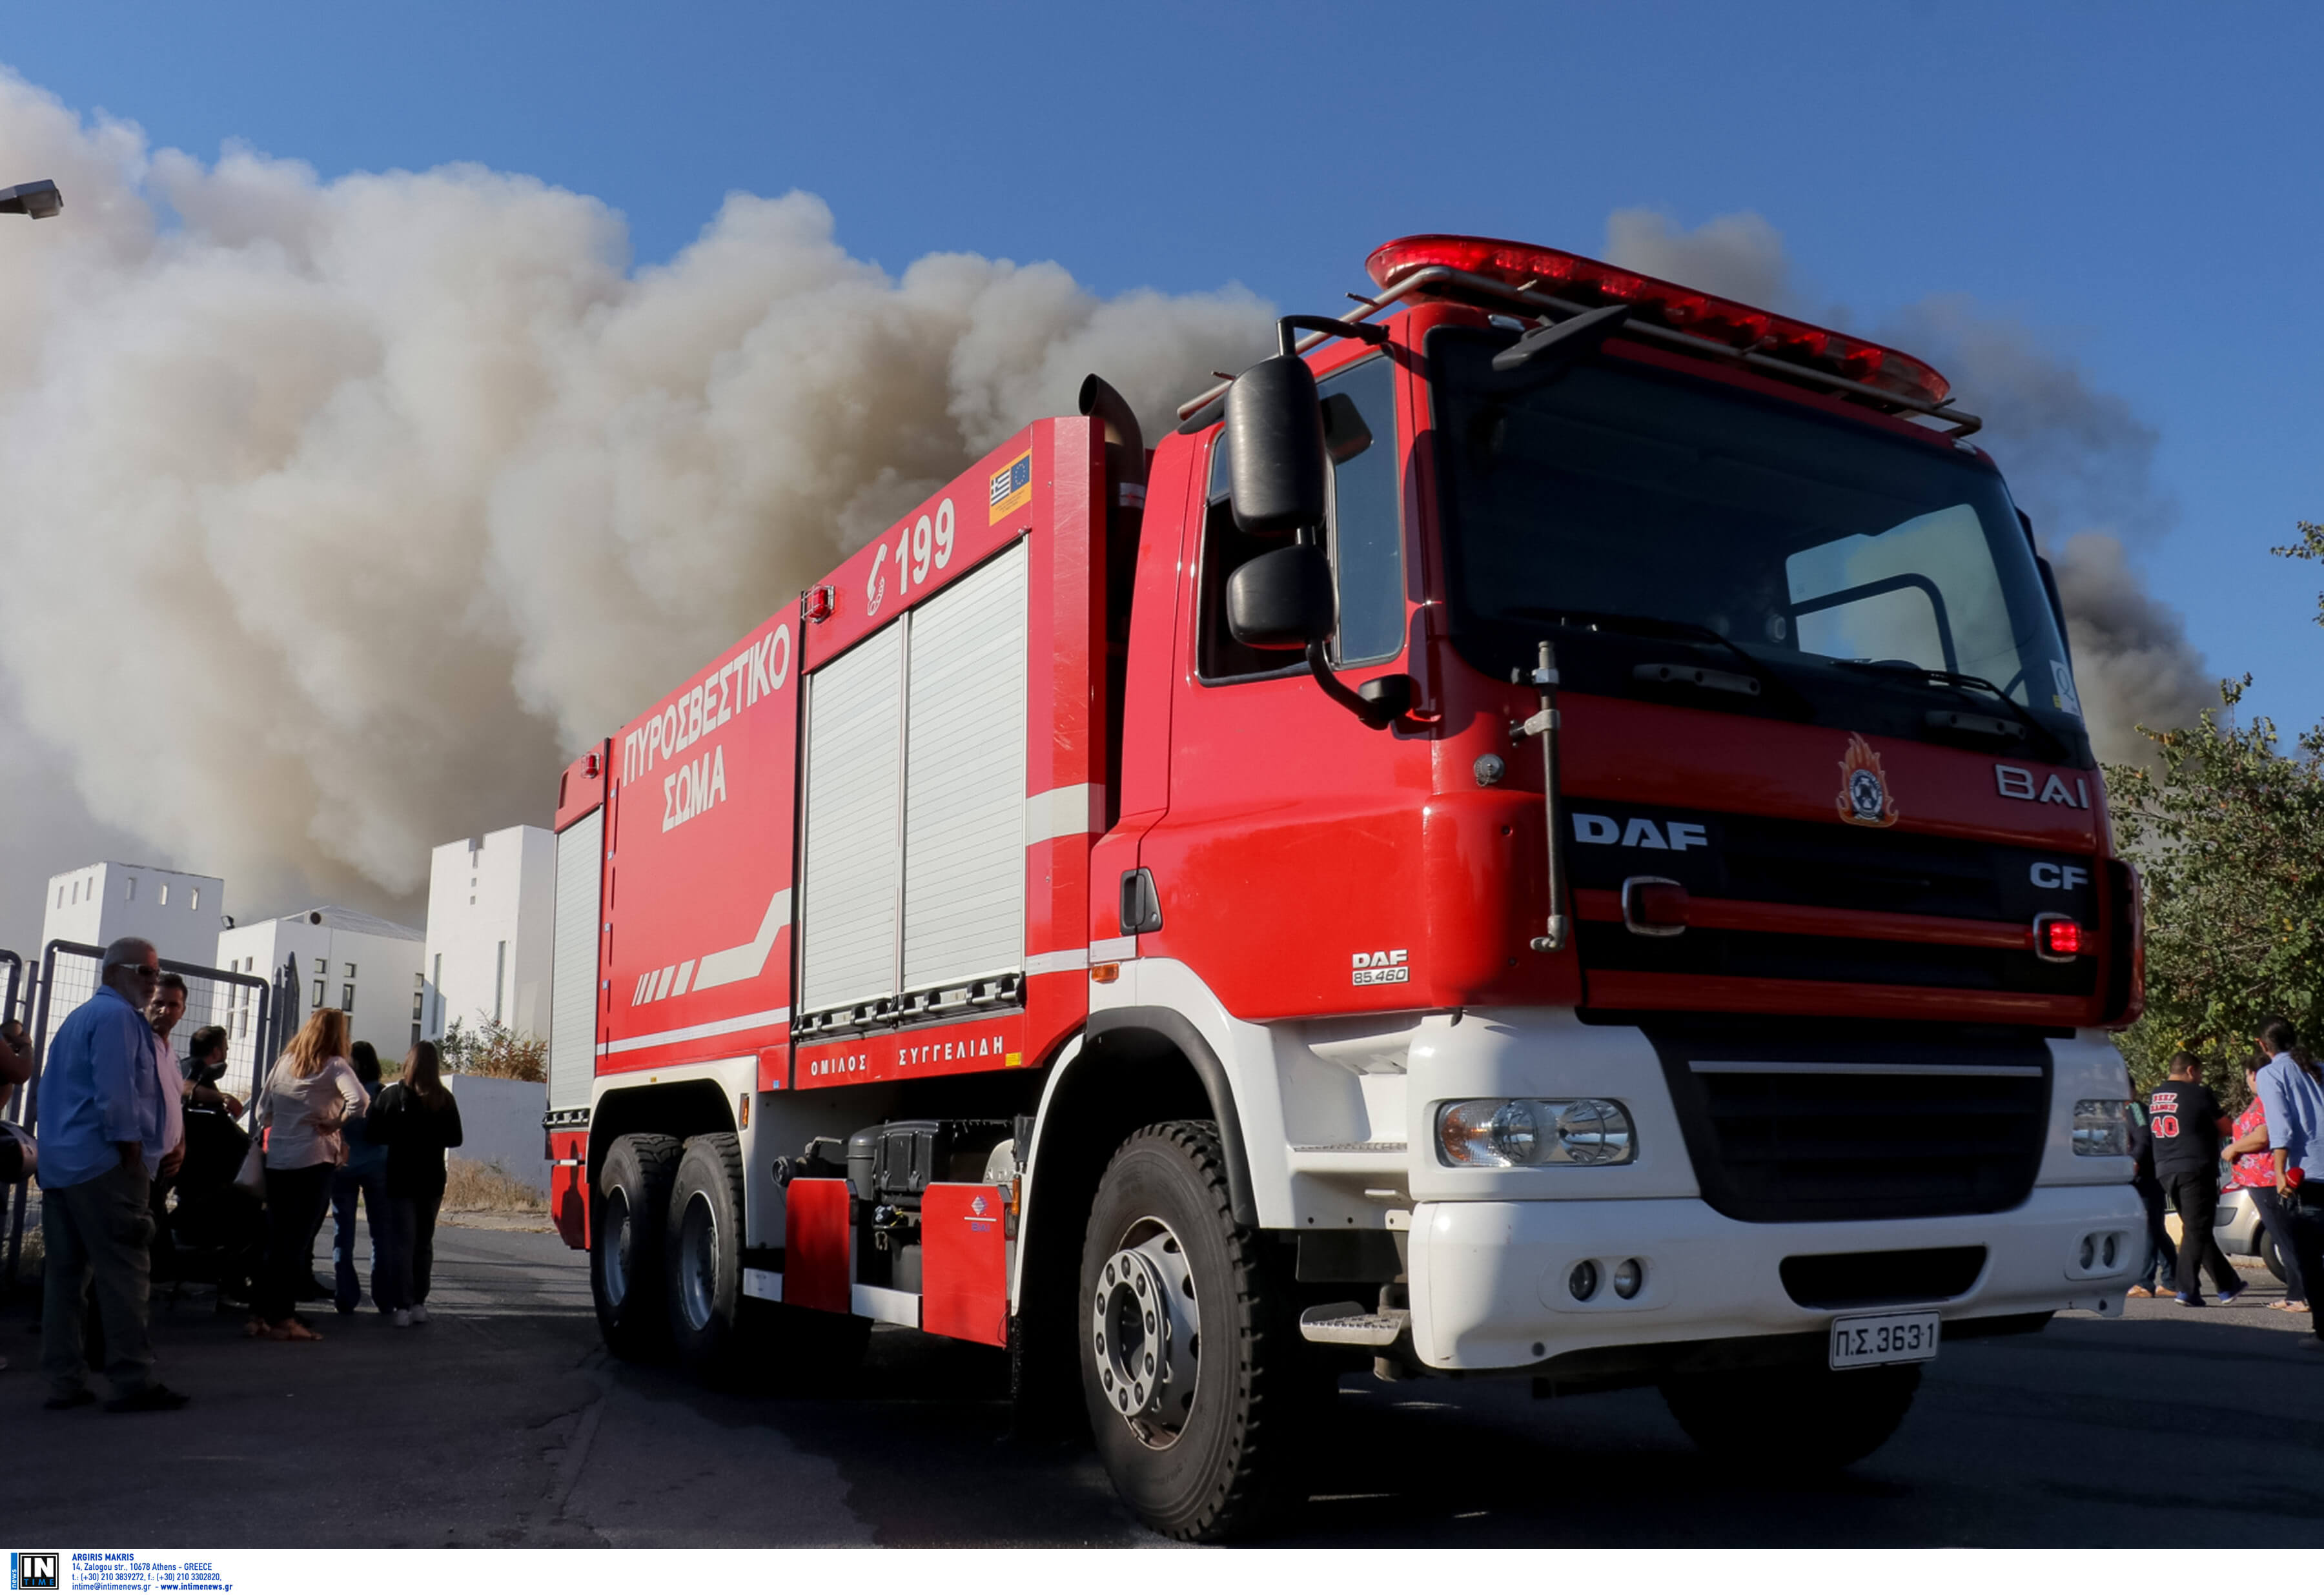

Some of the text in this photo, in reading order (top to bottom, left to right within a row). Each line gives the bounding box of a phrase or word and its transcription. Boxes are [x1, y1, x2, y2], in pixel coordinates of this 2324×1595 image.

[895, 498, 955, 594] 199
[623, 624, 790, 787] ΠΥΡΟΣΒΕΣΤΙΚΟ
[662, 744, 726, 833] ΣΩΜΑ
[1571, 813, 1708, 851] DAF
[2030, 862, 2089, 891] CF
[1352, 949, 1409, 969] DAF
[1354, 968, 1407, 984] 85.460
[811, 1054, 866, 1076] ΟΜΙΛΟΣ
[899, 1036, 1003, 1066] ΣΥΓΓΕΛΙΔΗ
[2151, 1115, 2179, 1139] 40
